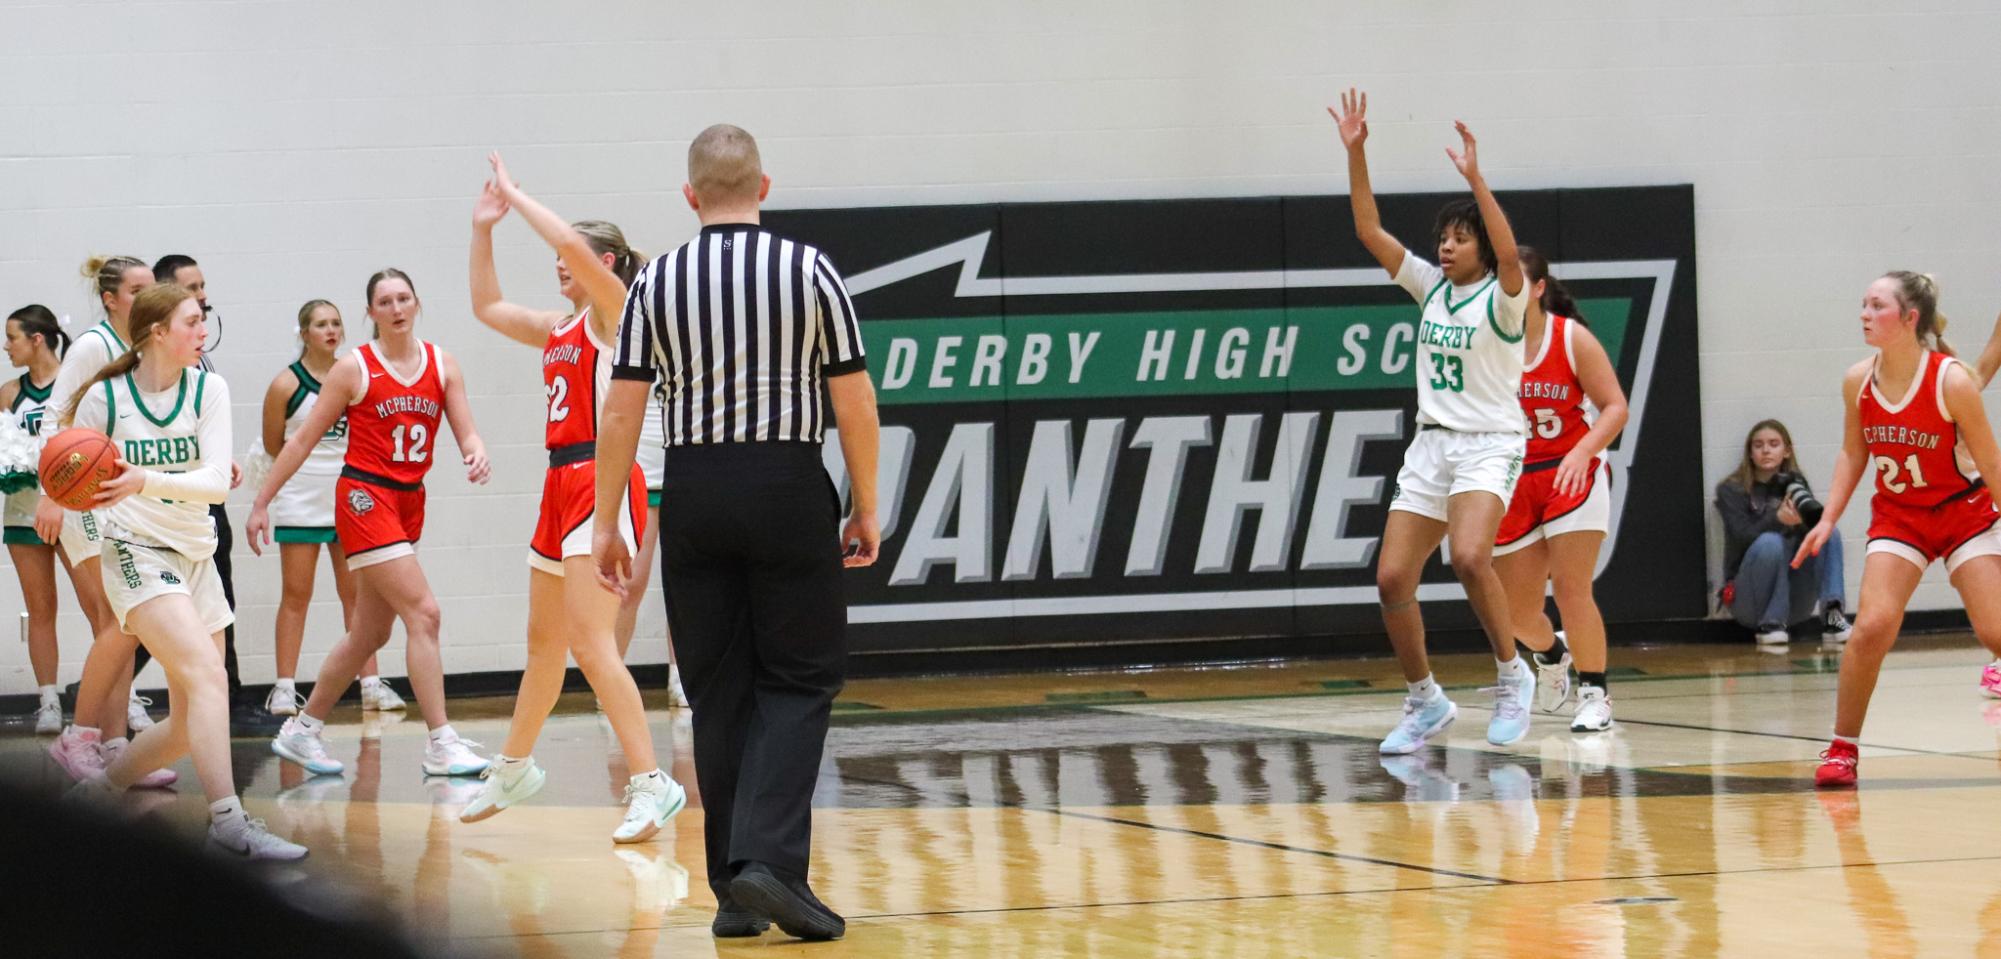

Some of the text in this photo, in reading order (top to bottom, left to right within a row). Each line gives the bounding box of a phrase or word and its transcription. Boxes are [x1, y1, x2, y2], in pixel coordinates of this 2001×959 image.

[1421, 320, 1476, 350] DERBY
[882, 331, 1101, 390] DERBY
[1136, 325, 1299, 382] HIGH
[1430, 352, 1464, 393] 33
[376, 395, 439, 418] MCPHERSON
[1518, 381, 1569, 401] ERSON
[124, 435, 200, 466] DERBY
[392, 424, 428, 463] 12
[1863, 426, 1940, 449] CPHERSON
[1875, 453, 1928, 494] 21
[822, 409, 1453, 587] PANTHE
[113, 540, 142, 589] ANTHERS
